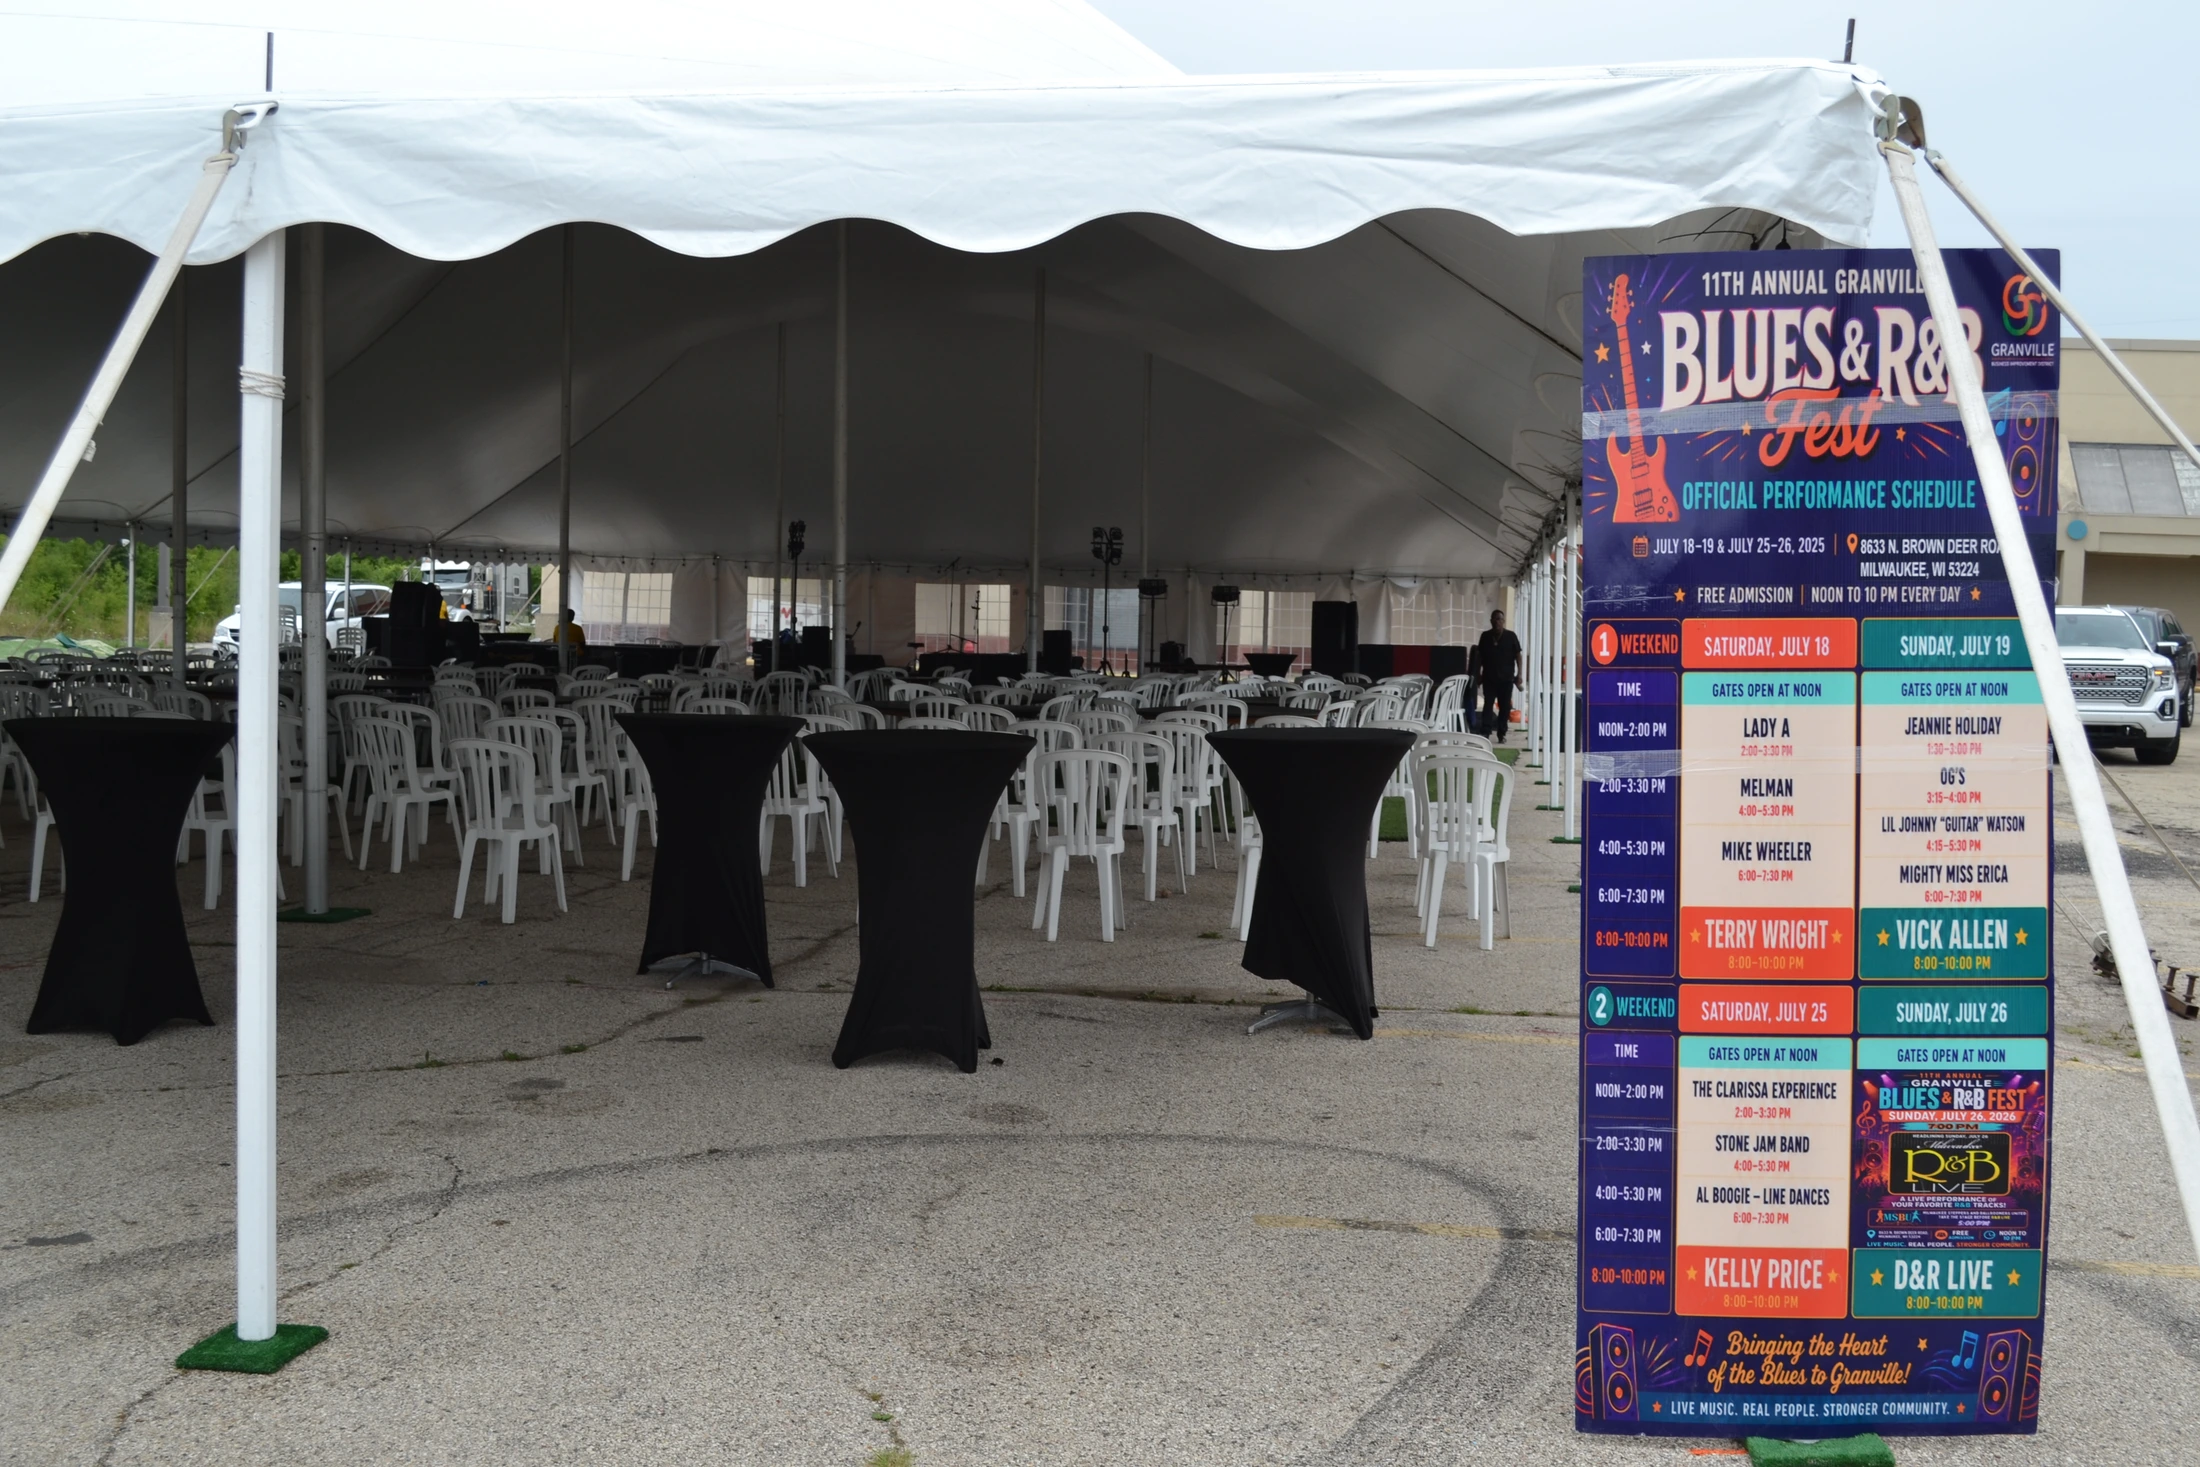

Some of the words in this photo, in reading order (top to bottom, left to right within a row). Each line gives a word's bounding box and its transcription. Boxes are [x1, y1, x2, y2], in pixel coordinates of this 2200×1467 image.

[1702, 272, 1744, 296] 11TH
[1751, 270, 1828, 295] ANNUAL
[1835, 269, 1925, 294] GRANVILL
[1659, 305, 1836, 412] BLUES
[1840, 318, 1871, 381] &
[1991, 343, 2055, 356] GRANVILLE
[1758, 386, 1884, 467] Fest
[1683, 481, 1757, 509] OFFICIAL
[1763, 480, 1886, 509] PERFORMANCE
[1892, 480, 1976, 508] SCHEDULE
[1654, 538, 1679, 554] JULY
[1717, 539, 1724, 553] &
[1728, 538, 1754, 553] JULY
[1799, 538, 1825, 553] 2025
[1861, 539, 1885, 554] 8633
[1888, 539, 1899, 554] N.
[1902, 539, 1945, 554] BROWN
[1948, 539, 1978, 554] DEER
[1861, 562, 1929, 578] MILWAUKEE,
[1932, 562, 1945, 576] WI
[1948, 562, 1979, 576] 53224
[1698, 587, 1725, 603] FREE
[1729, 587, 1793, 603] ADMISSION
[1811, 587, 1843, 603] NOON
[1847, 587, 1861, 602] TO
[1864, 587, 1876, 602] 10
[1881, 587, 1897, 602] PM
[1902, 587, 1937, 602] EVERY
[1940, 587, 1960, 602] DAY
[1600, 632, 1609, 656] 1
[1621, 634, 1678, 654] WEEKEND
[1705, 637, 1774, 657] SATURDAY,
[1779, 637, 1810, 656] JULY
[1815, 637, 1829, 656] 18
[1900, 636, 1956, 658] SUNDAY,
[1960, 636, 1991, 655] JULY
[1996, 636, 2010, 655] 19
[2072, 673, 2115, 681] GMC
[1617, 683, 1641, 696] TIME
[1713, 684, 1744, 697] GATES
[1748, 684, 1774, 697] OPEN
[1779, 684, 1790, 697] AT
[1794, 684, 1821, 697] NOON
[1653, 723, 1666, 736] PM
[1744, 718, 1777, 737] LADY
[1782, 718, 1790, 737] A
[1905, 717, 1951, 735] JEANNIE
[1956, 717, 2001, 734] HOLIDAY
[1741, 779, 1792, 797] MELMAN
[1882, 817, 1895, 833] LIL
[1899, 817, 1937, 832] JOHNNY
[1987, 816, 2025, 832] WATSON
[1722, 842, 1752, 860] MIKE
[1756, 842, 1811, 860] WHEELER
[1900, 865, 1942, 883] MIGHTY
[1947, 865, 1973, 883] MISS
[1977, 865, 2008, 883] ERICA
[1705, 919, 1757, 949] TERRY
[1762, 920, 1828, 949] WRIGHT
[1897, 920, 1943, 950] VICK
[1949, 919, 2008, 949] ALLEN
[1976, 956, 1990, 969] PM
[1596, 994, 1606, 1018] 2
[1616, 997, 1675, 1018] WEEKEND
[1702, 1001, 1771, 1023] SATURDAY,
[1776, 1003, 1807, 1022] JULY
[1812, 1003, 1827, 1022] 25
[1896, 1003, 1951, 1025] SUNDAY,
[1956, 1003, 1987, 1022] JULY
[1991, 1003, 2007, 1022] 26
[1615, 1044, 1638, 1058] TIME
[1693, 1081, 1712, 1097] THE
[1716, 1081, 1768, 1098] CLARISSA
[1772, 1082, 1836, 1100] EXPERIENCE
[1879, 1088, 1939, 1109] BLUES
[1942, 1092, 1952, 1104] &
[1954, 1089, 1984, 1110] R&B
[1988, 1090, 2027, 1110] FEST
[1941, 1112, 1968, 1121] JULY
[1990, 1112, 2016, 1120] 2026
[1716, 1135, 1749, 1152] STONE
[1753, 1136, 1776, 1152] JAM
[1780, 1137, 1809, 1153] BAND
[1904, 1150, 2000, 1182] R&B
[1696, 1187, 1709, 1203] AL
[1713, 1187, 1750, 1204] BOOGIE
[1763, 1189, 1785, 1205] LINE
[1790, 1189, 1829, 1205] DANCES
[1913, 1183, 1984, 1193] LIVE
[1883, 1213, 1912, 1221] MSBU
[1705, 1257, 1762, 1288] KELLY
[1768, 1259, 1822, 1289] PRICE
[1894, 1260, 1940, 1290] D&R
[1948, 1260, 1993, 1289] LIVE
[1727, 1331, 1805, 1364] Bringing
[1808, 1335, 1834, 1355] the
[1838, 1333, 1888, 1355] Heart
[1708, 1365, 1726, 1393] of
[1730, 1362, 1756, 1383] the
[1760, 1362, 1806, 1384] Blues
[1811, 1365, 1827, 1384] to
[1831, 1362, 1911, 1394] Granville!
[1671, 1402, 1695, 1415] LIVE
[1699, 1402, 1738, 1416] MUSIC.
[1743, 1403, 1770, 1416] REAL
[1775, 1403, 1818, 1417] PEOPLE.
[1823, 1402, 1877, 1417] STRONGER
[1882, 1402, 1950, 1415] COMMUNITY.
